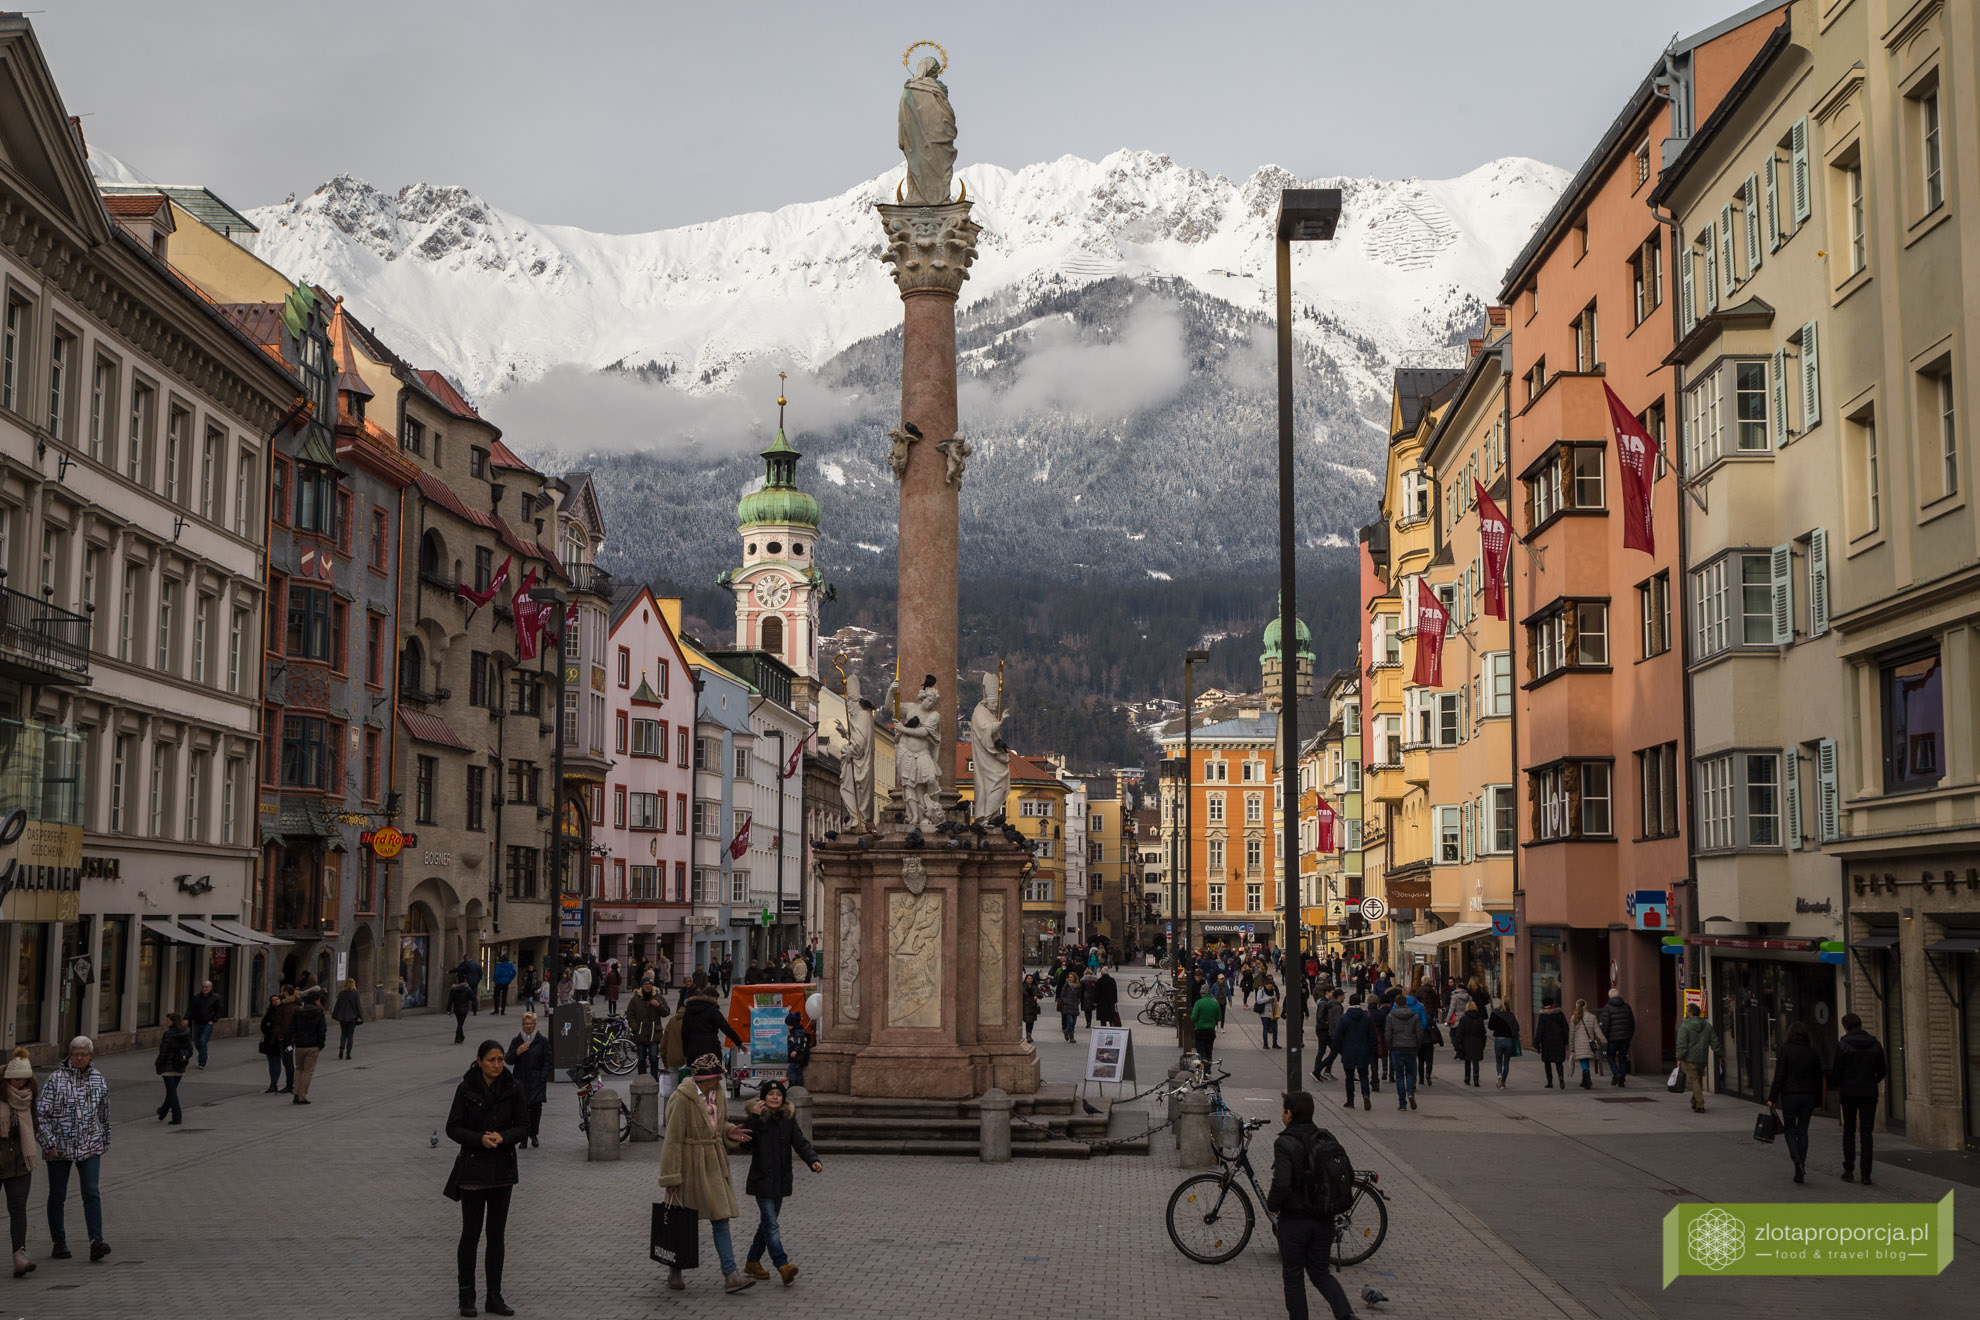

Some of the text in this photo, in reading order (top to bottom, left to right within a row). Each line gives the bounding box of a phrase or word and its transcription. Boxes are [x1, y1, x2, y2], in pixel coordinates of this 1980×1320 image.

[27, 828, 39, 841] DAS
[361, 831, 414, 848] Hard Rock
[424, 851, 451, 866] BOGNER
